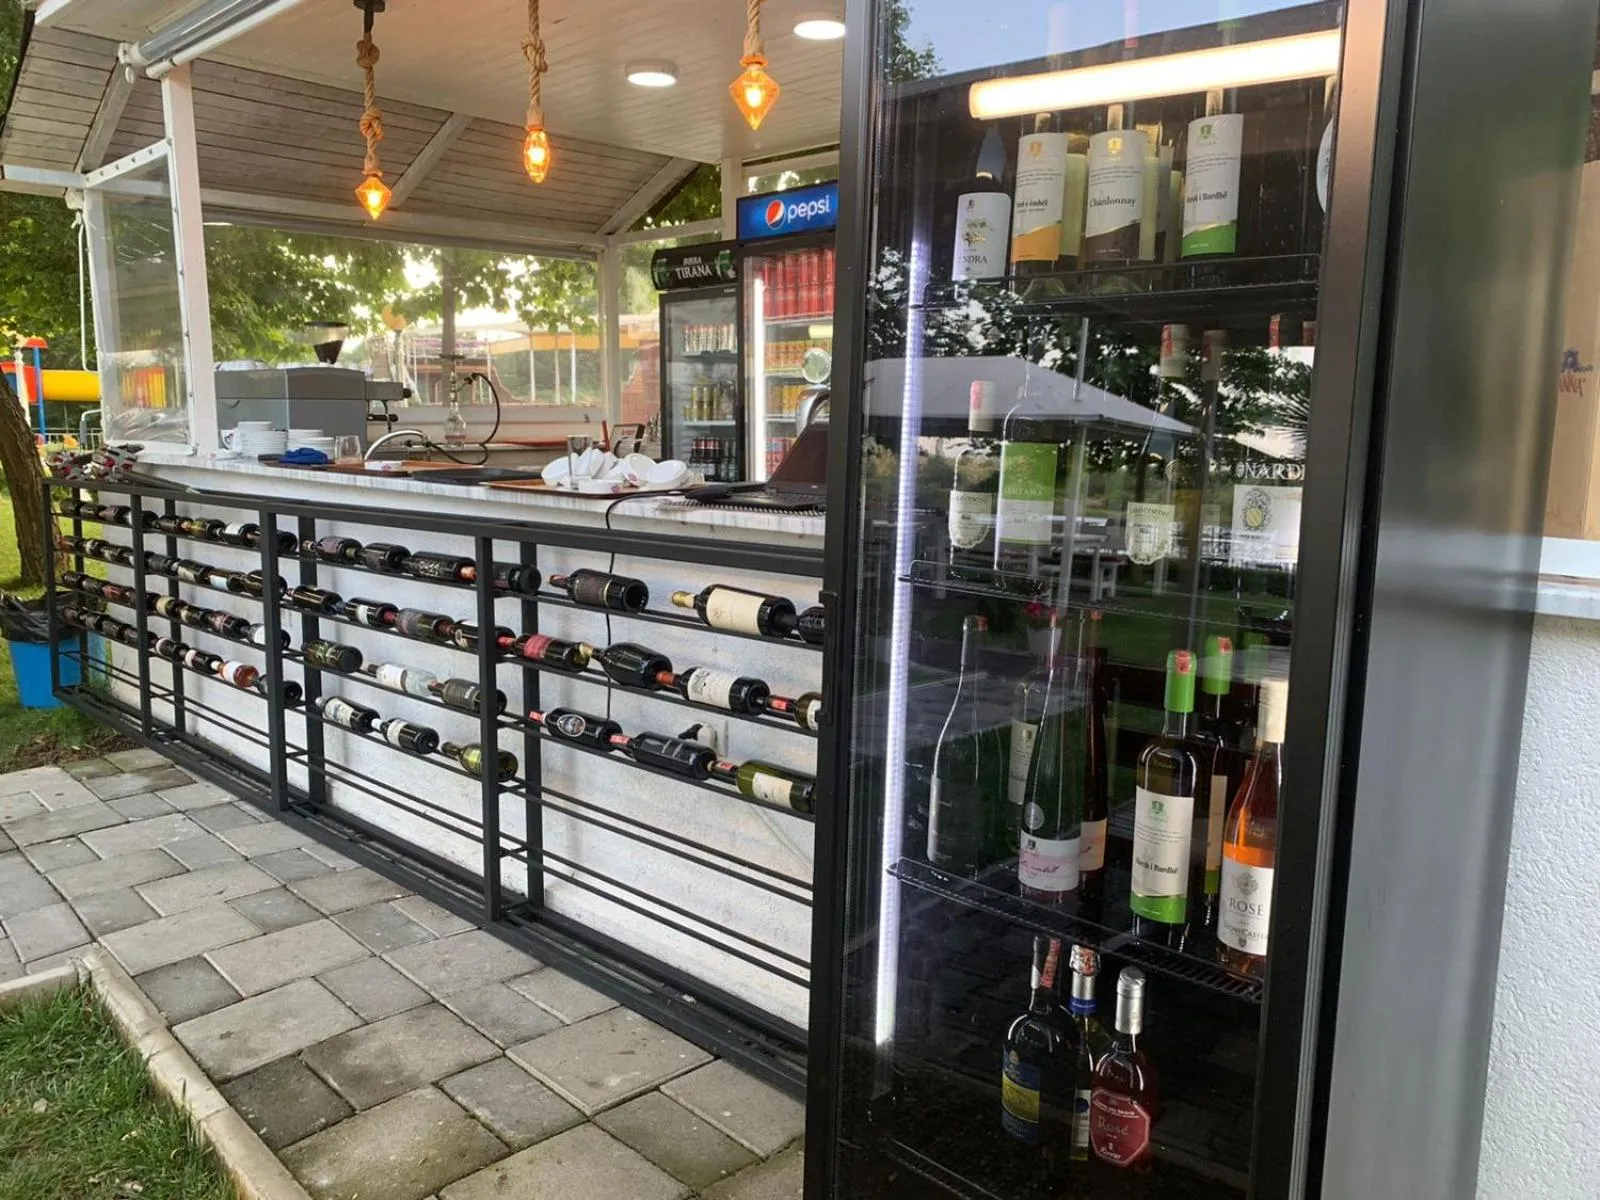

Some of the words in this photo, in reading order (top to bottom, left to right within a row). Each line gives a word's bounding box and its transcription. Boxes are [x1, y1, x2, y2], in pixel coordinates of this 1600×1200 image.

[788, 195, 830, 223] pepsi
[1089, 196, 1137, 208] Chardonnay
[683, 256, 702, 267] BIRRA
[675, 265, 712, 281] TIRANA
